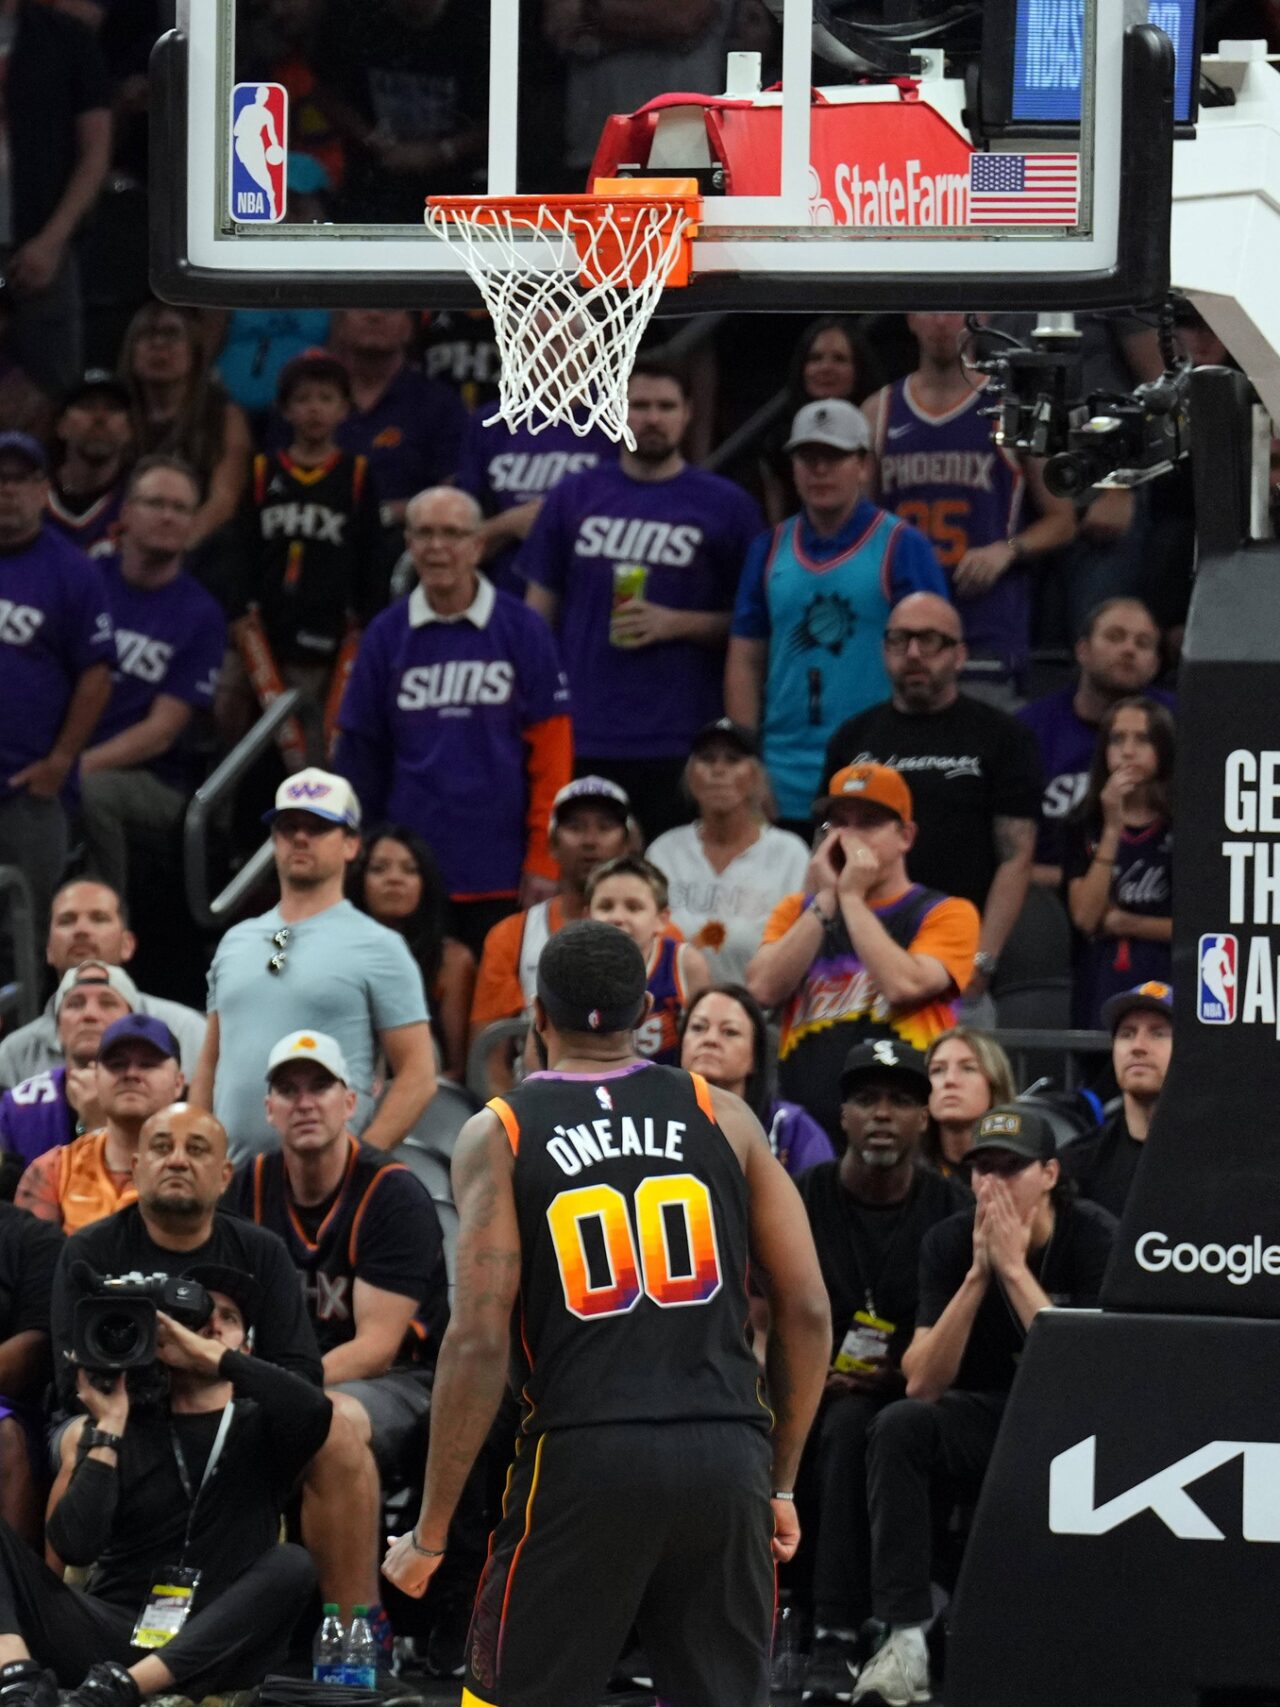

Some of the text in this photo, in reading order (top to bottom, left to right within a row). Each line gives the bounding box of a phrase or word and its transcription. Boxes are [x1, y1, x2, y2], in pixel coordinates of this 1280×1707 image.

[237, 191, 264, 214] NBA
[880, 452, 997, 494] PHOENIX
[546, 1116, 687, 1177] O'NEALE
[546, 1173, 724, 1322] 00
[1134, 1231, 1280, 1285] Google
